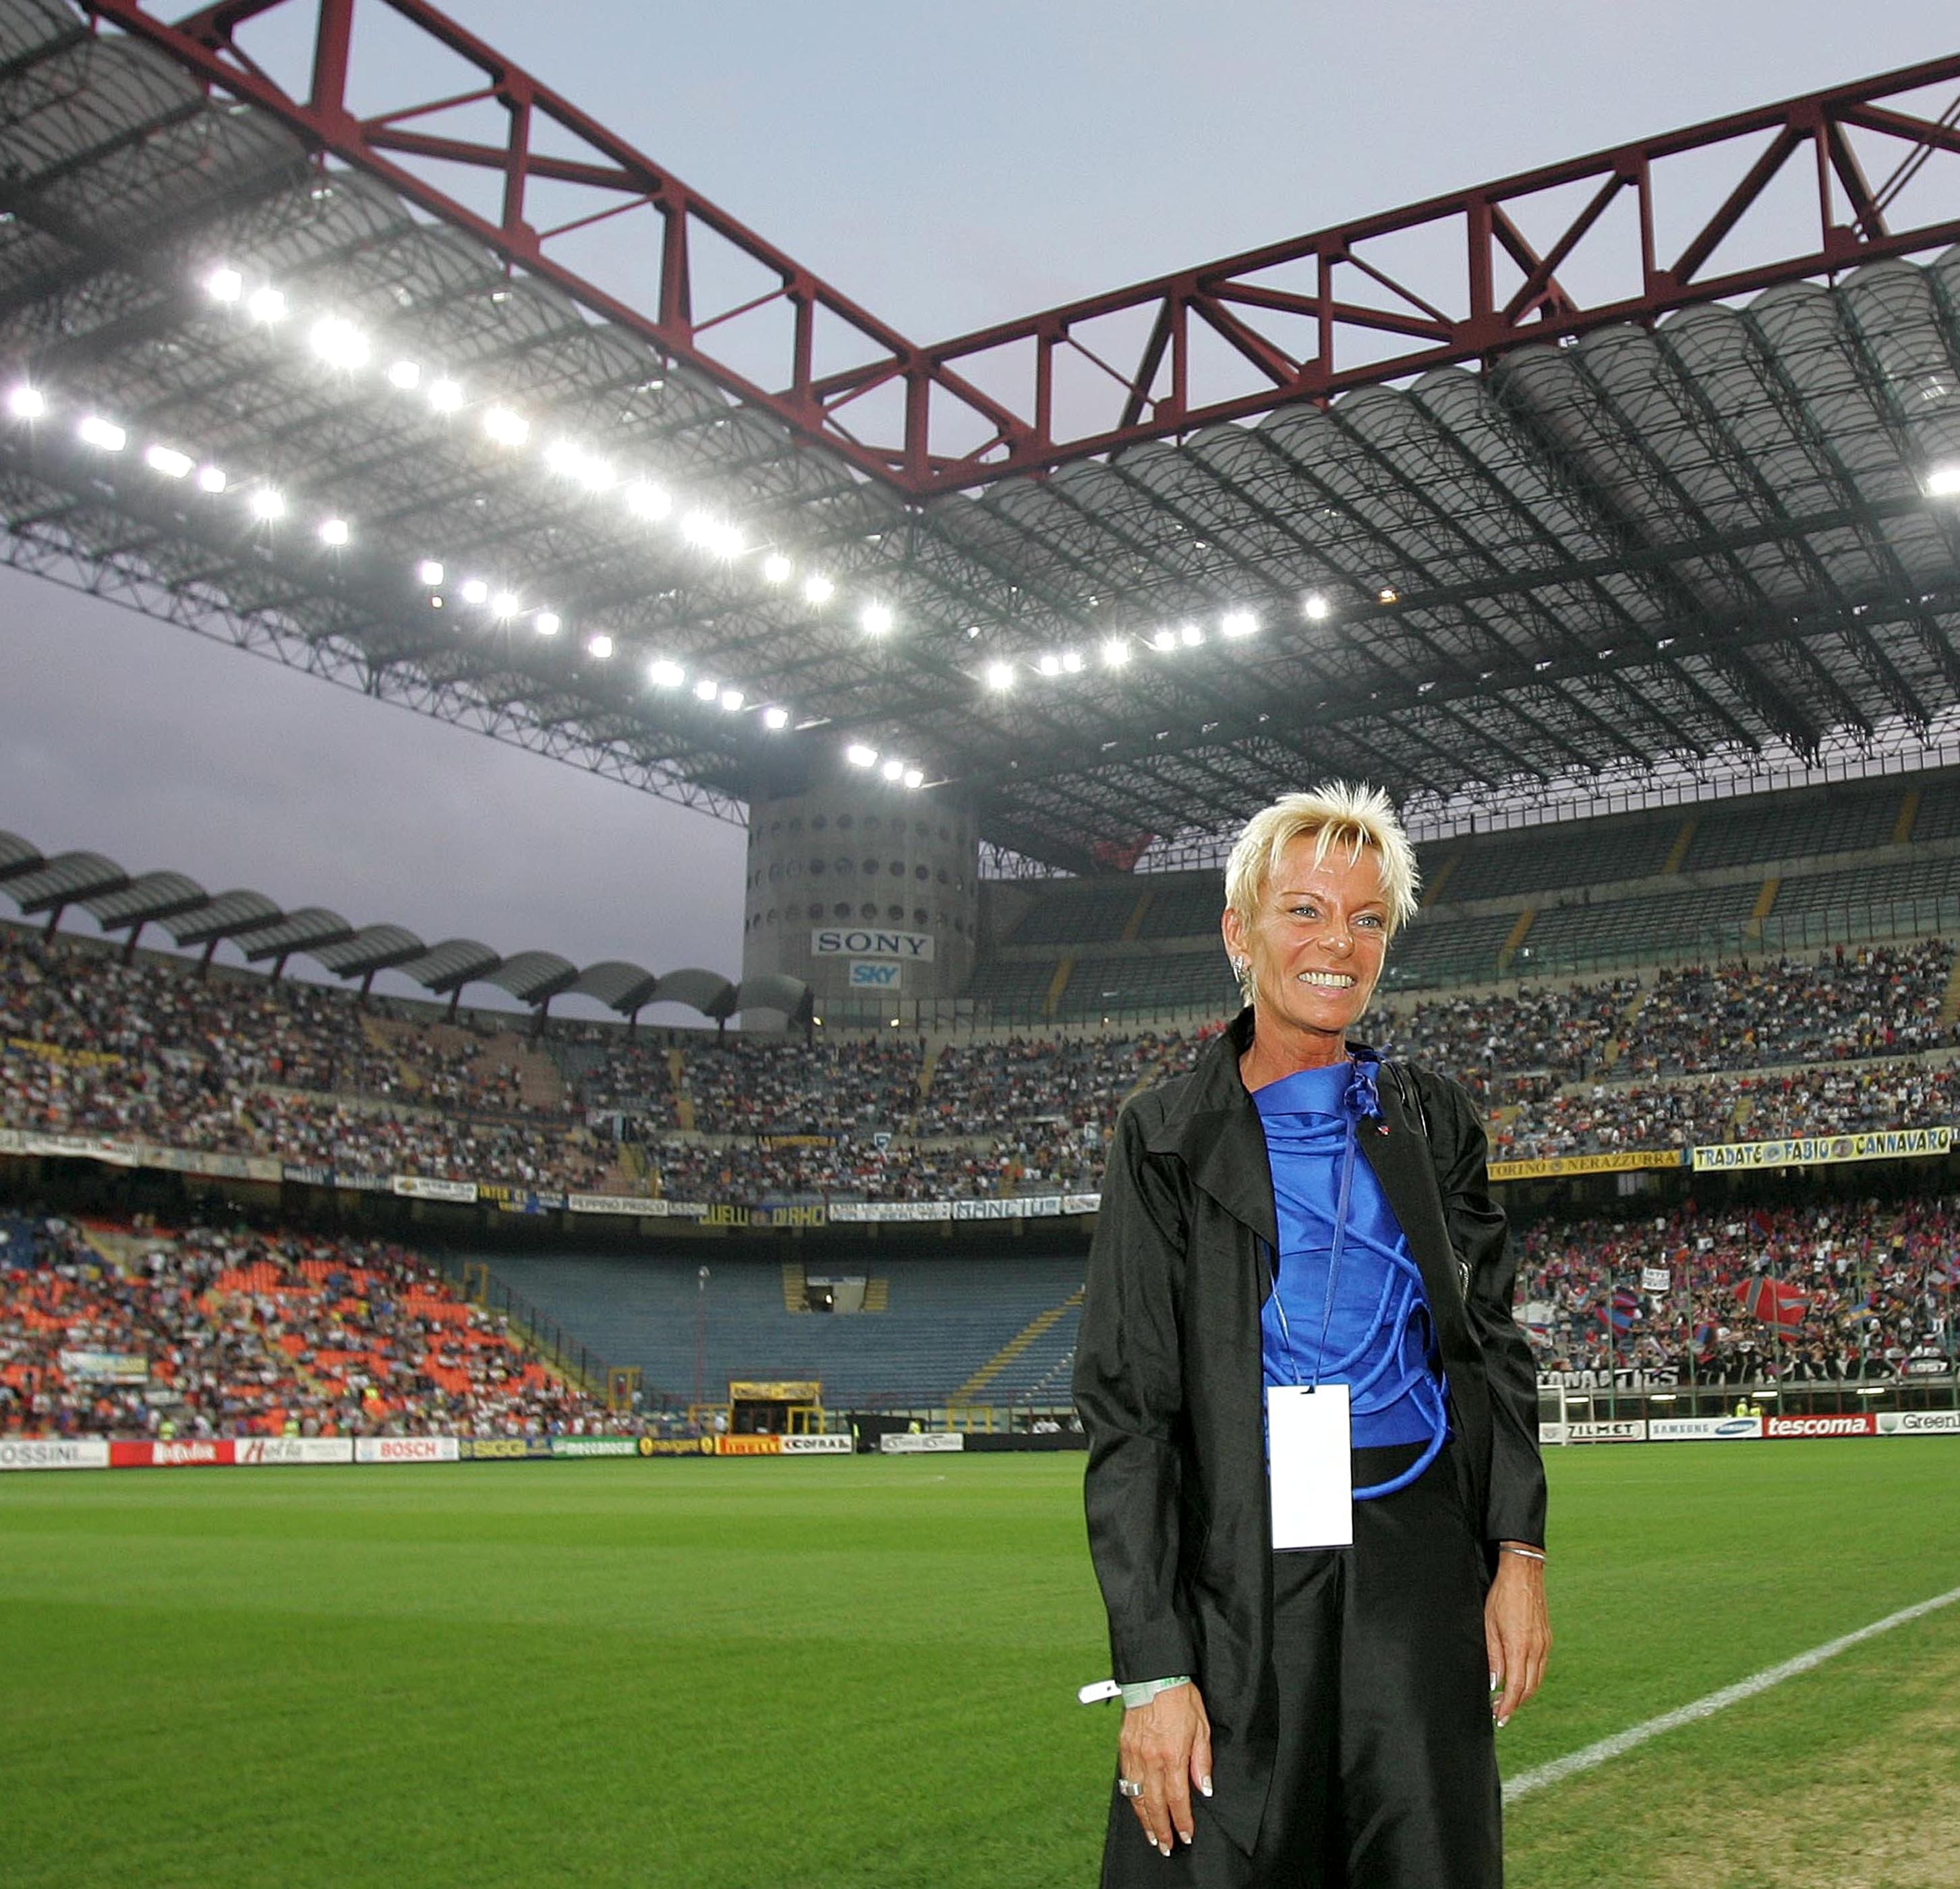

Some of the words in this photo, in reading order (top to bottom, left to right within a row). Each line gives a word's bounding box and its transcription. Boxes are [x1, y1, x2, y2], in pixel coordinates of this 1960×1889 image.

[819, 932, 925, 955] SONY
[853, 965, 899, 984] SKY
[1696, 1144, 1762, 1166] TRADATE
[1784, 1139, 1830, 1161] FABIO
[1856, 1129, 1949, 1155] CANNAVARO
[1489, 1161, 1546, 1178] TORINO
[1567, 1152, 1676, 1172] NERAZZURRA
[1653, 1423, 1709, 1434] SAMSUNG
[380, 1441, 436, 1457] BOSCH
